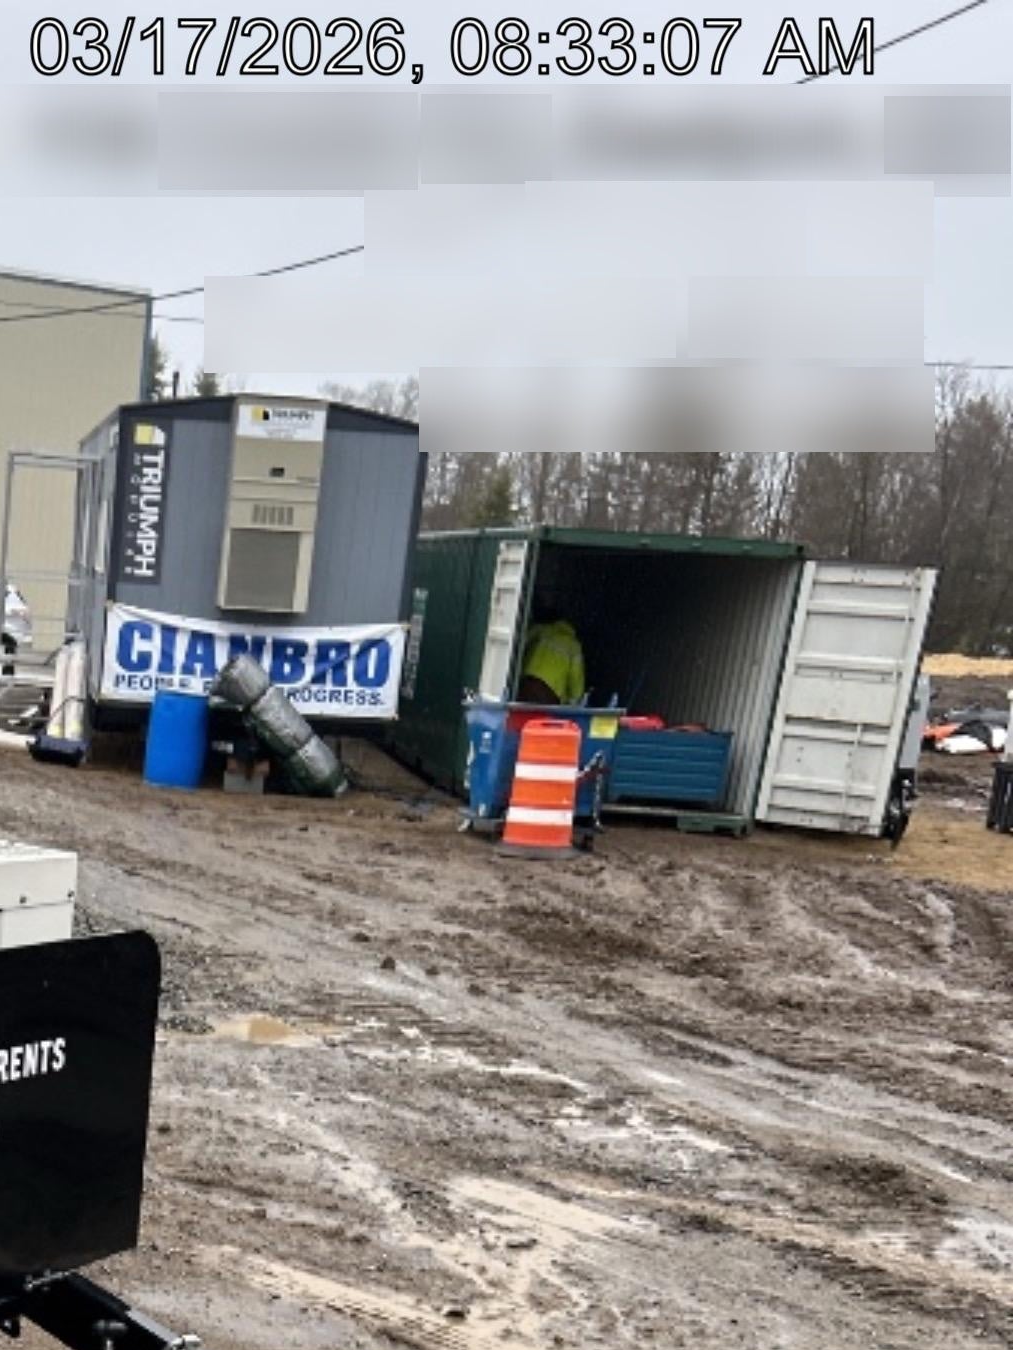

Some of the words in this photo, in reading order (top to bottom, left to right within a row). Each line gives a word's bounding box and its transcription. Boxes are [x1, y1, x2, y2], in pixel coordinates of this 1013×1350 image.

[133, 449, 166, 577] TRIUMPH
[116, 620, 393, 688] CIANBRO
[285, 685, 387, 706] ROGRESS.
